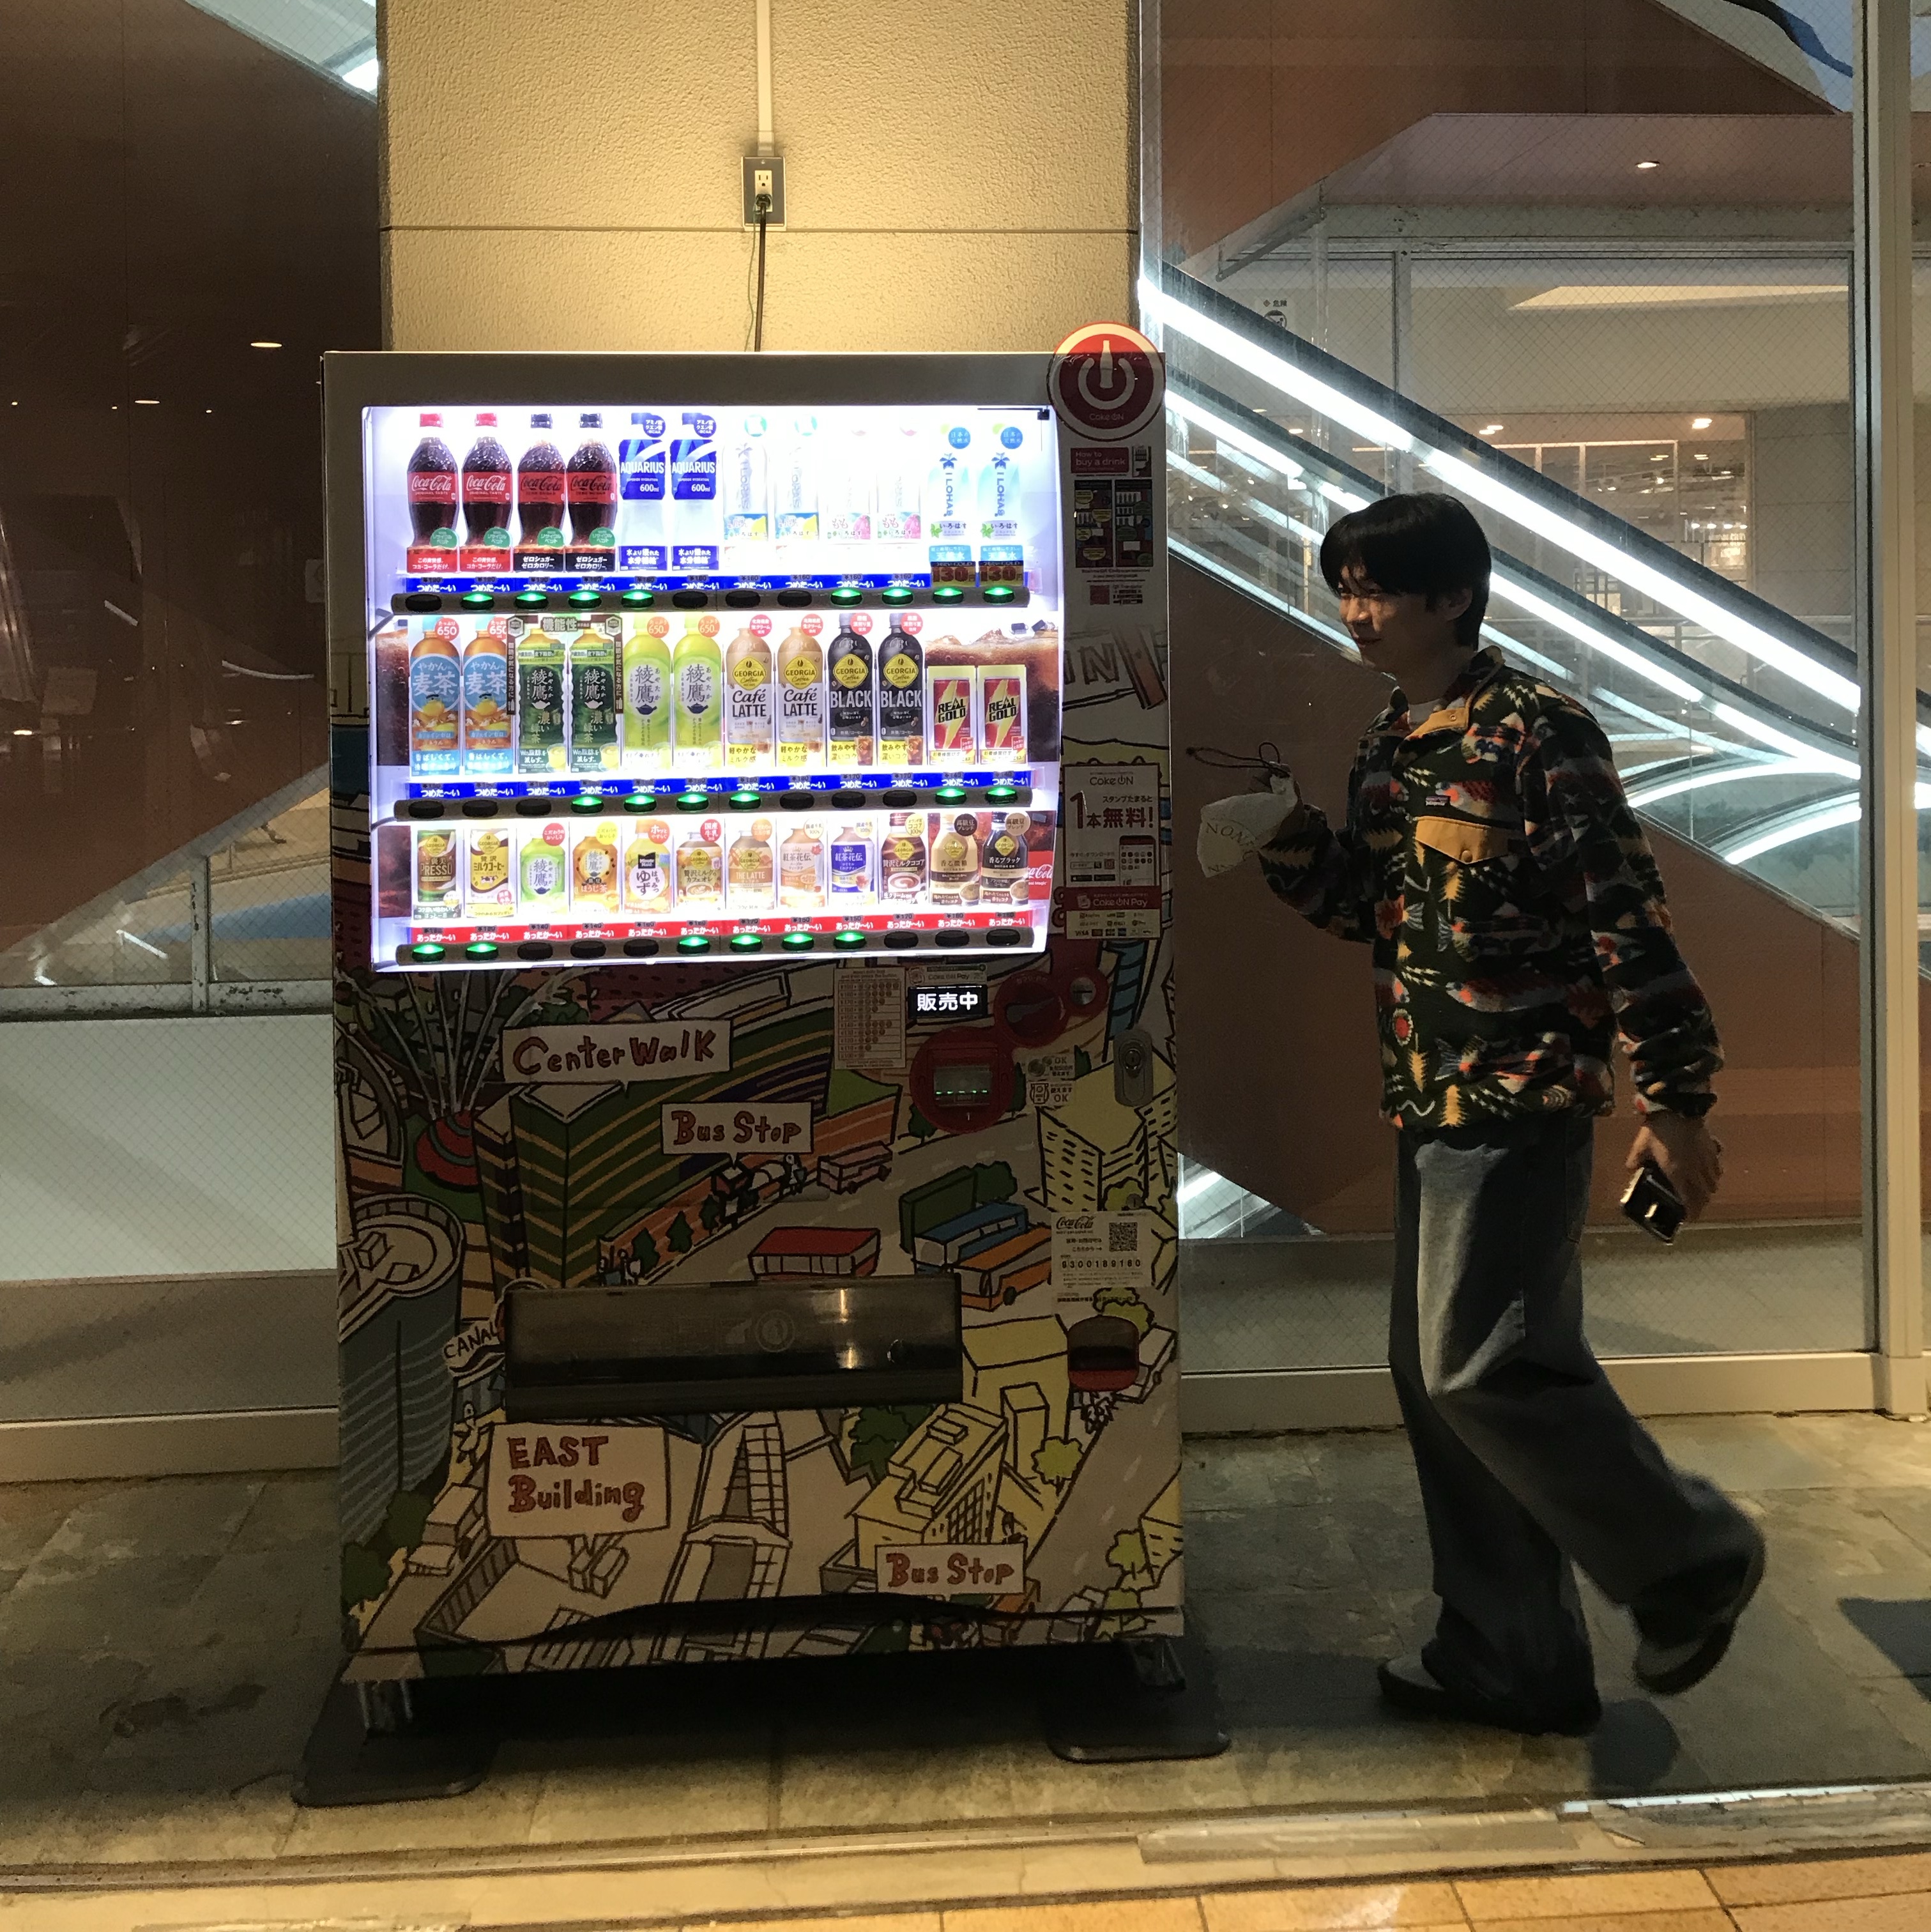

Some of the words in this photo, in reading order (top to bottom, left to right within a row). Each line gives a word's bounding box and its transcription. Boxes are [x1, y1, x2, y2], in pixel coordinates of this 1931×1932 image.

[621, 462, 664, 474] AQUARIUS
[672, 462, 715, 474] AQUARIUS
[437, 627, 457, 636] 650
[413, 671, 458, 696] 麦茶
[466, 670, 507, 696] 麦茶
[531, 669, 548, 700] 綾鷹
[584, 669, 600, 700] 綾鷹
[635, 664, 654, 703] 綾鷹
[686, 664, 705, 702] 綾鷹
[732, 689, 766, 703] Café
[784, 688, 817, 703] Café
[830, 690, 872, 708] BLACK
[881, 690, 922, 708] BLACK
[732, 704, 767, 717] LATTE
[784, 703, 818, 716] LATTE
[938, 698, 966, 713] REAL
[989, 696, 1017, 713] REAL
[938, 707, 966, 723] GOLD
[989, 707, 1017, 723] GOLD
[1090, 776, 1116, 786] Coke
[1118, 775, 1134, 785] ON
[782, 853, 812, 861] 紅茶花伝
[835, 853, 863, 861] 紅茶花伝
[883, 859, 925, 868] 贅沢ミルクココア
[474, 862, 504, 871] ミルクコーヒー
[533, 859, 548, 886] 綾鷹
[636, 870, 651, 896] ゆず
[651, 871, 660, 893] はちみつ
[736, 871, 746, 880] THE
[581, 884, 607, 893] ほうじ茶
[1093, 898, 1115, 907] Coke
[1116, 898, 1129, 906] ON
[1131, 898, 1148, 908] Pay
[917, 992, 979, 1011] 販売中
[513, 1035, 625, 1075] Center
[671, 1110, 725, 1145] Bus
[444, 1322, 501, 1358] CANAL
[507, 1436, 609, 1469] EAST
[508, 1475, 645, 1522] Building
[886, 1552, 939, 1587] Bus
